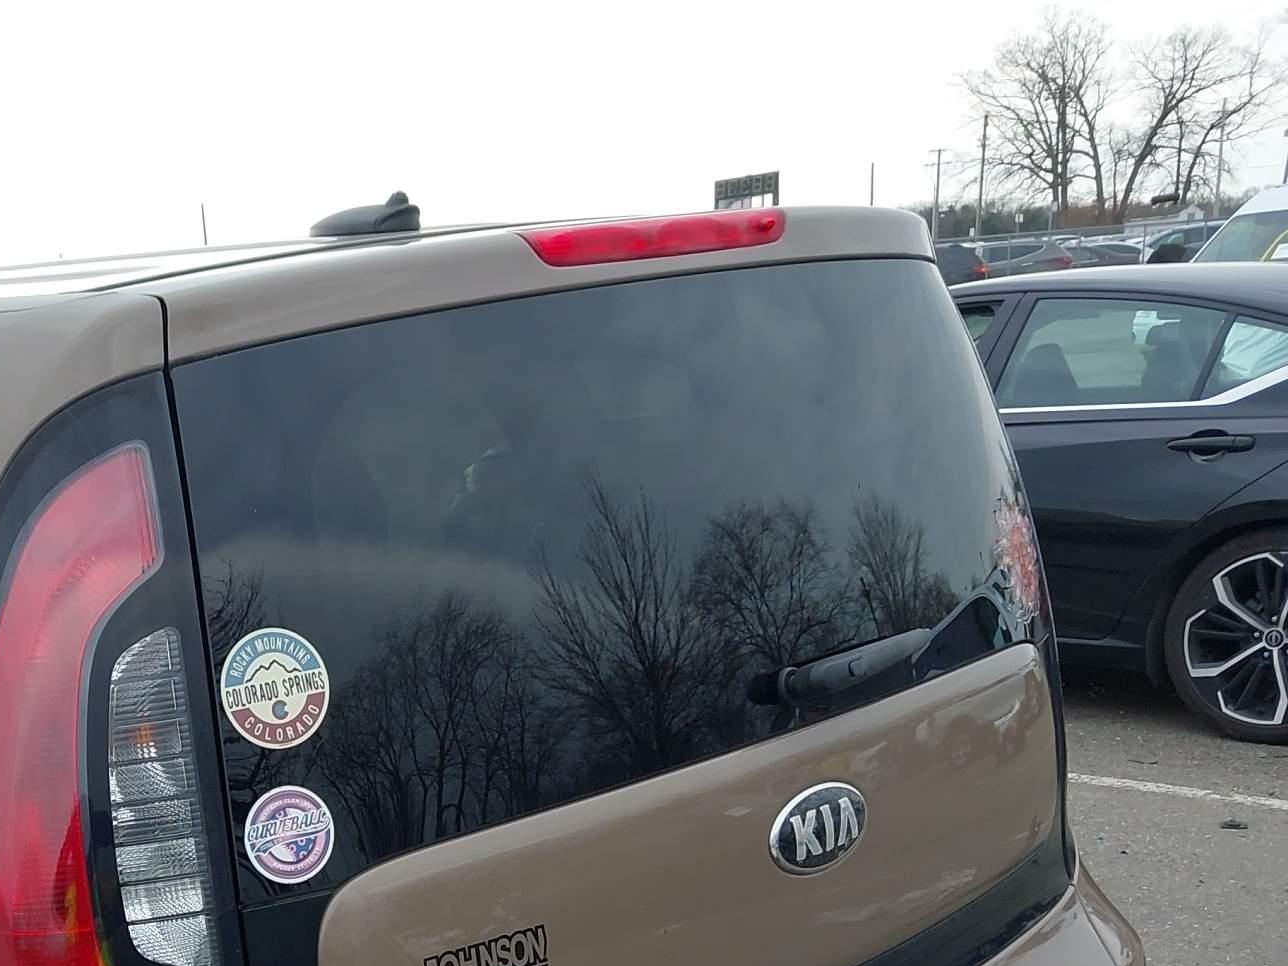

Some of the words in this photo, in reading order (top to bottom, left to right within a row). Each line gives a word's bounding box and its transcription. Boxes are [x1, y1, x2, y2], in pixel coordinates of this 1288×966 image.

[230, 645, 254, 678] ROCKY
[254, 636, 311, 665] MOUNTAINS
[225, 680, 279, 709] COLORADO
[281, 671, 326, 697] SPRINGS
[244, 704, 320, 741] COLORADO
[248, 809, 327, 842] CURVEBALL
[789, 796, 859, 861] KIA
